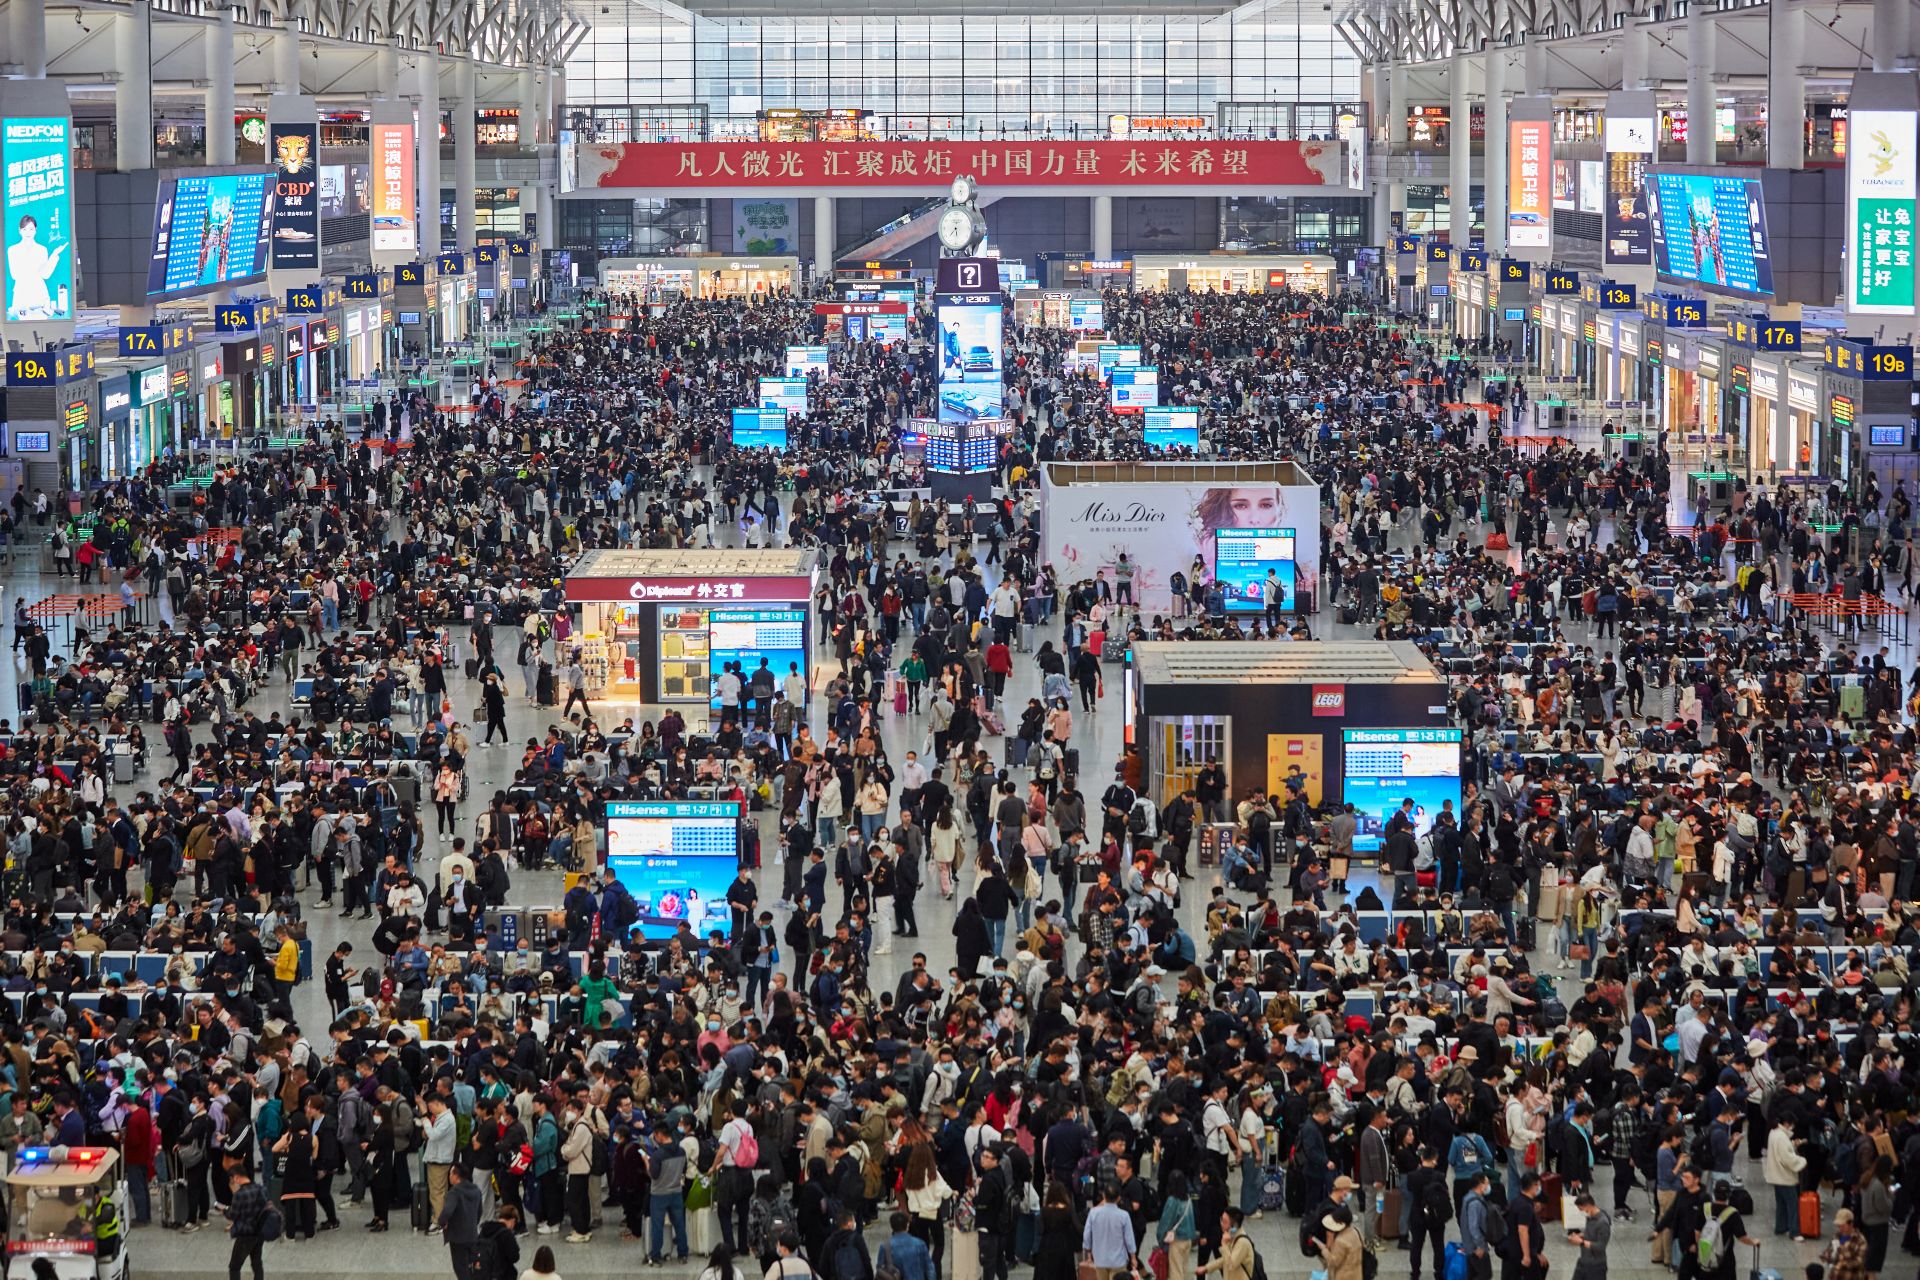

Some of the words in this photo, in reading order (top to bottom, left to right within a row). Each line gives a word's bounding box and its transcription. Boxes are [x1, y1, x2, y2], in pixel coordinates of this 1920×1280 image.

[7, 125, 64, 138] NEDFON
[676, 149, 804, 178] 凡人微光
[822, 149, 953, 177] 汇聚成炬
[972, 148, 1101, 176] 中国力量
[1120, 148, 1250, 176] 未来希望
[384, 150, 402, 211] 浪鲸卫浴
[1522, 146, 1538, 208] 浪鲸卫浴
[276, 182, 310, 196] CBD
[284, 196, 302, 206] 家居
[1894, 208, 1911, 266] 兔宝宝
[513, 244, 524, 253] 3A
[1403, 241, 1414, 250] 3B
[1874, 208, 1892, 287] 让家更好
[480, 252, 492, 261] 5A
[1434, 248, 1446, 258] 5B
[444, 260, 456, 270] 7A
[1468, 256, 1481, 268] 7B
[402, 270, 416, 280] 9A
[1509, 266, 1522, 278] 9B
[351, 281, 372, 292] 11A
[1552, 276, 1572, 288] 11B
[293, 294, 316, 308] 13A
[1607, 290, 1630, 303] 13B
[222, 311, 247, 325] 15A
[1675, 306, 1700, 320] 15B
[126, 334, 156, 350] 17A
[1764, 328, 1794, 344] 17B
[14, 360, 47, 378] 19A
[1872, 354, 1904, 372] 19B
[1070, 502, 1120, 522] Miss
[1124, 502, 1166, 522] Dior
[698, 584, 744, 598] 外交官
[716, 612, 754, 620] Hisense
[1313, 694, 1343, 707] LEGO
[1351, 732, 1400, 742] Hisense
[1420, 732, 1434, 740] 1-25
[614, 805, 668, 815] Hisense
[692, 806, 708, 814] 1-27
